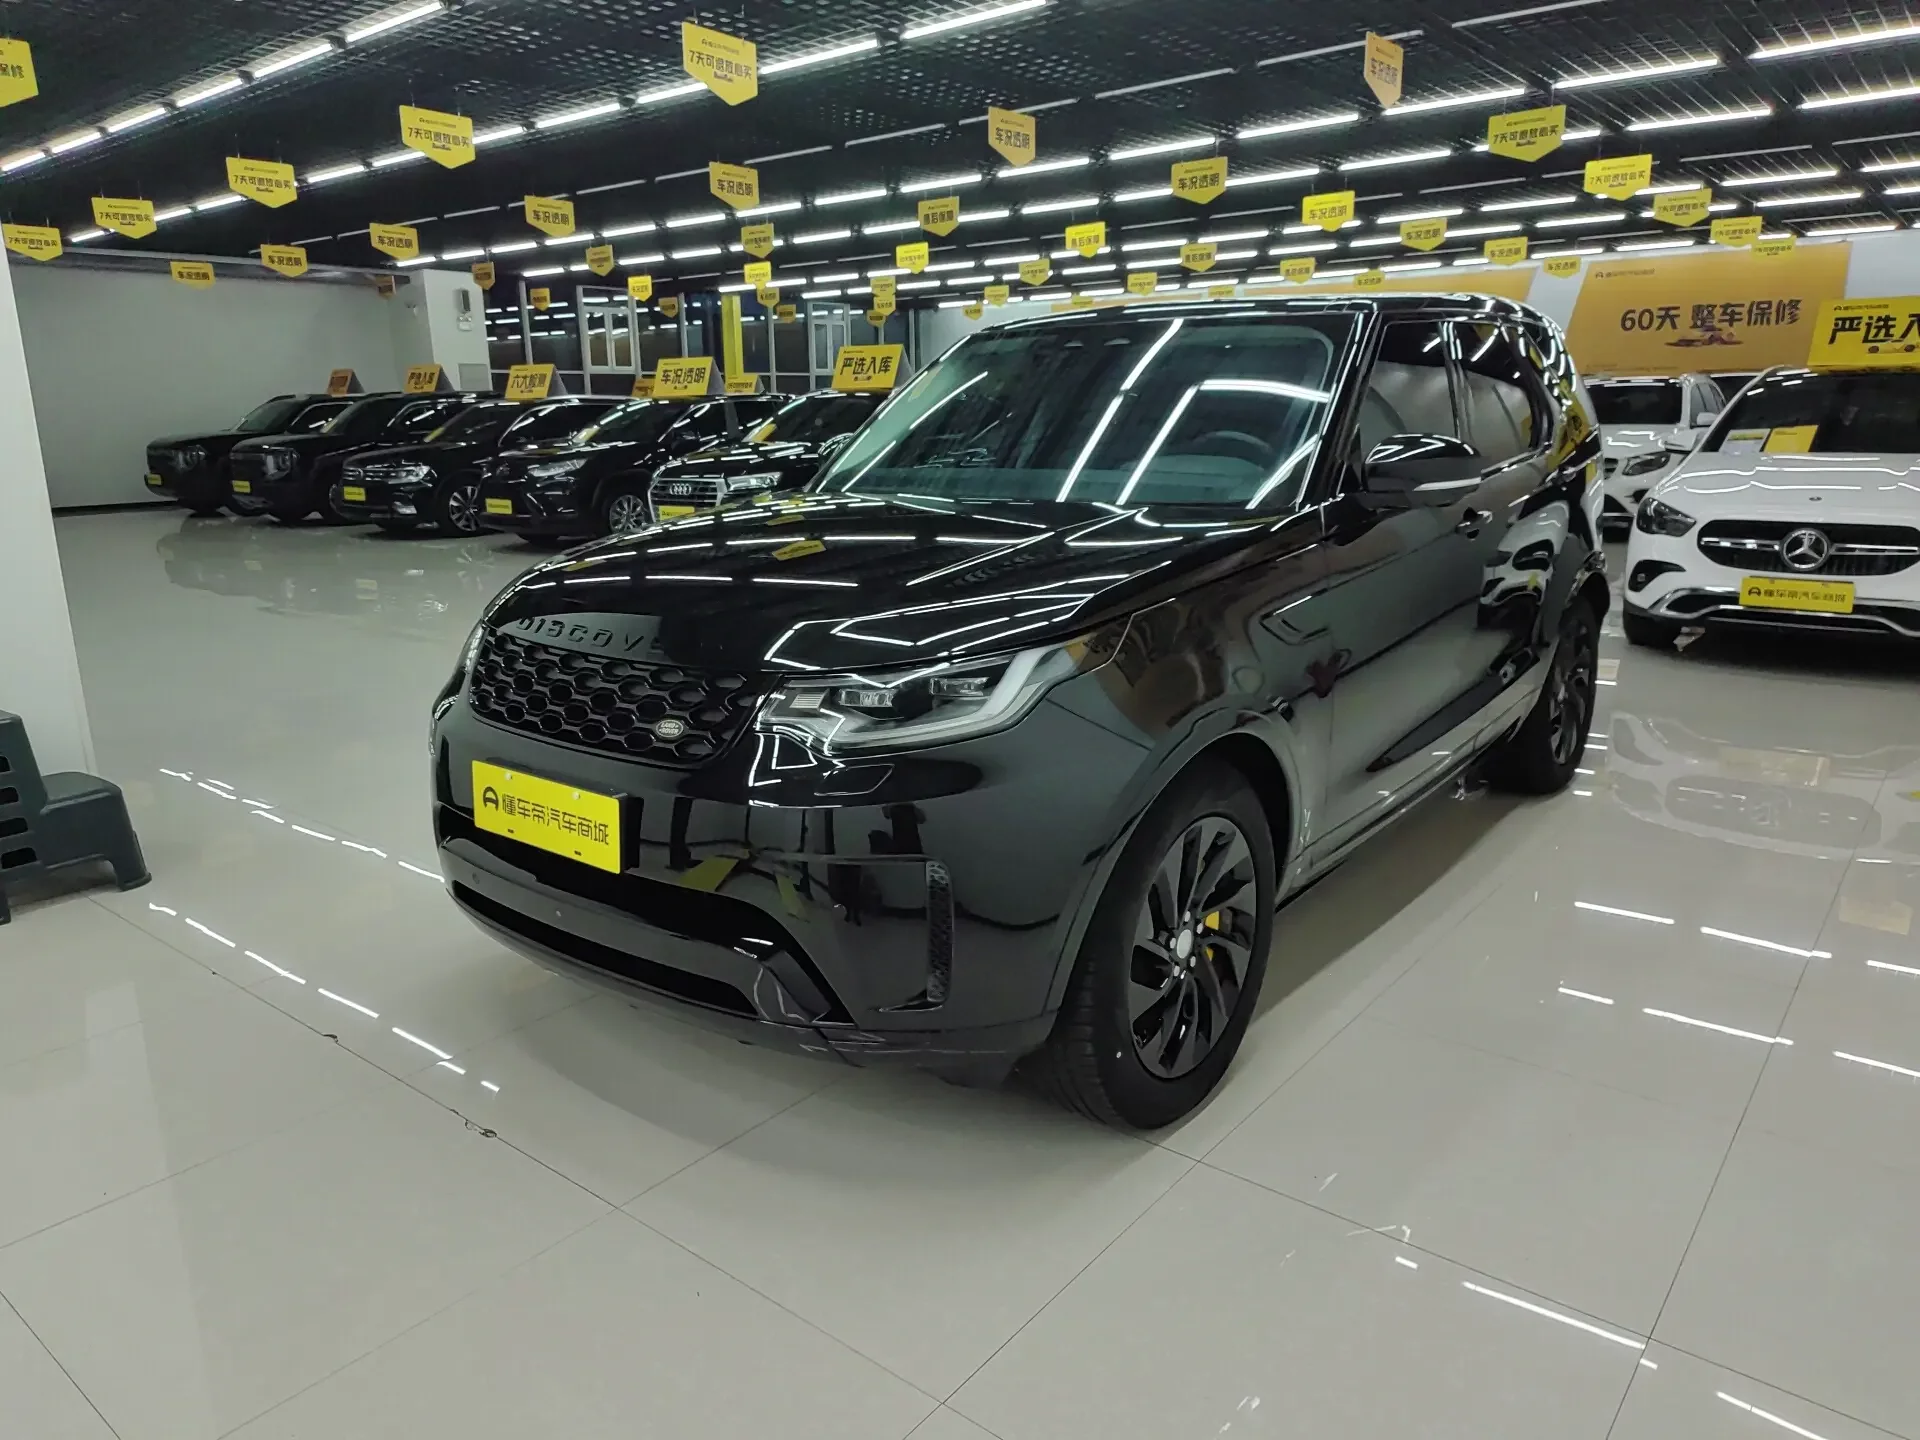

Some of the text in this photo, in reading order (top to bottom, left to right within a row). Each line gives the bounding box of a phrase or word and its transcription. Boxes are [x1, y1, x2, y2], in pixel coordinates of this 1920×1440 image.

[689, 49, 752, 80] 7天可退放心买
[407, 126, 470, 148] 7天可退放心买
[995, 126, 1030, 150] 车况透明
[1493, 124, 1559, 144] 7天可退放心买
[232, 174, 292, 190] 7天可退放心买
[717, 178, 754, 197] 车况透明
[1178, 172, 1220, 191] 车况透明
[1589, 170, 1646, 186] 7天可退放心买
[532, 210, 570, 226] 车况透明
[1309, 205, 1348, 219] 车况透明
[377, 235, 413, 249] 车况透明
[1405, 227, 1441, 240] 车况透明
[268, 254, 302, 267] 车况透明
[1620, 298, 1803, 332] 60天 整车保修
[840, 355, 893, 376] 严选入库
[661, 366, 706, 385] 车况透明
[516, 616, 661, 653] DISCOV
[502, 792, 610, 846] 懂车帝汽车商城
